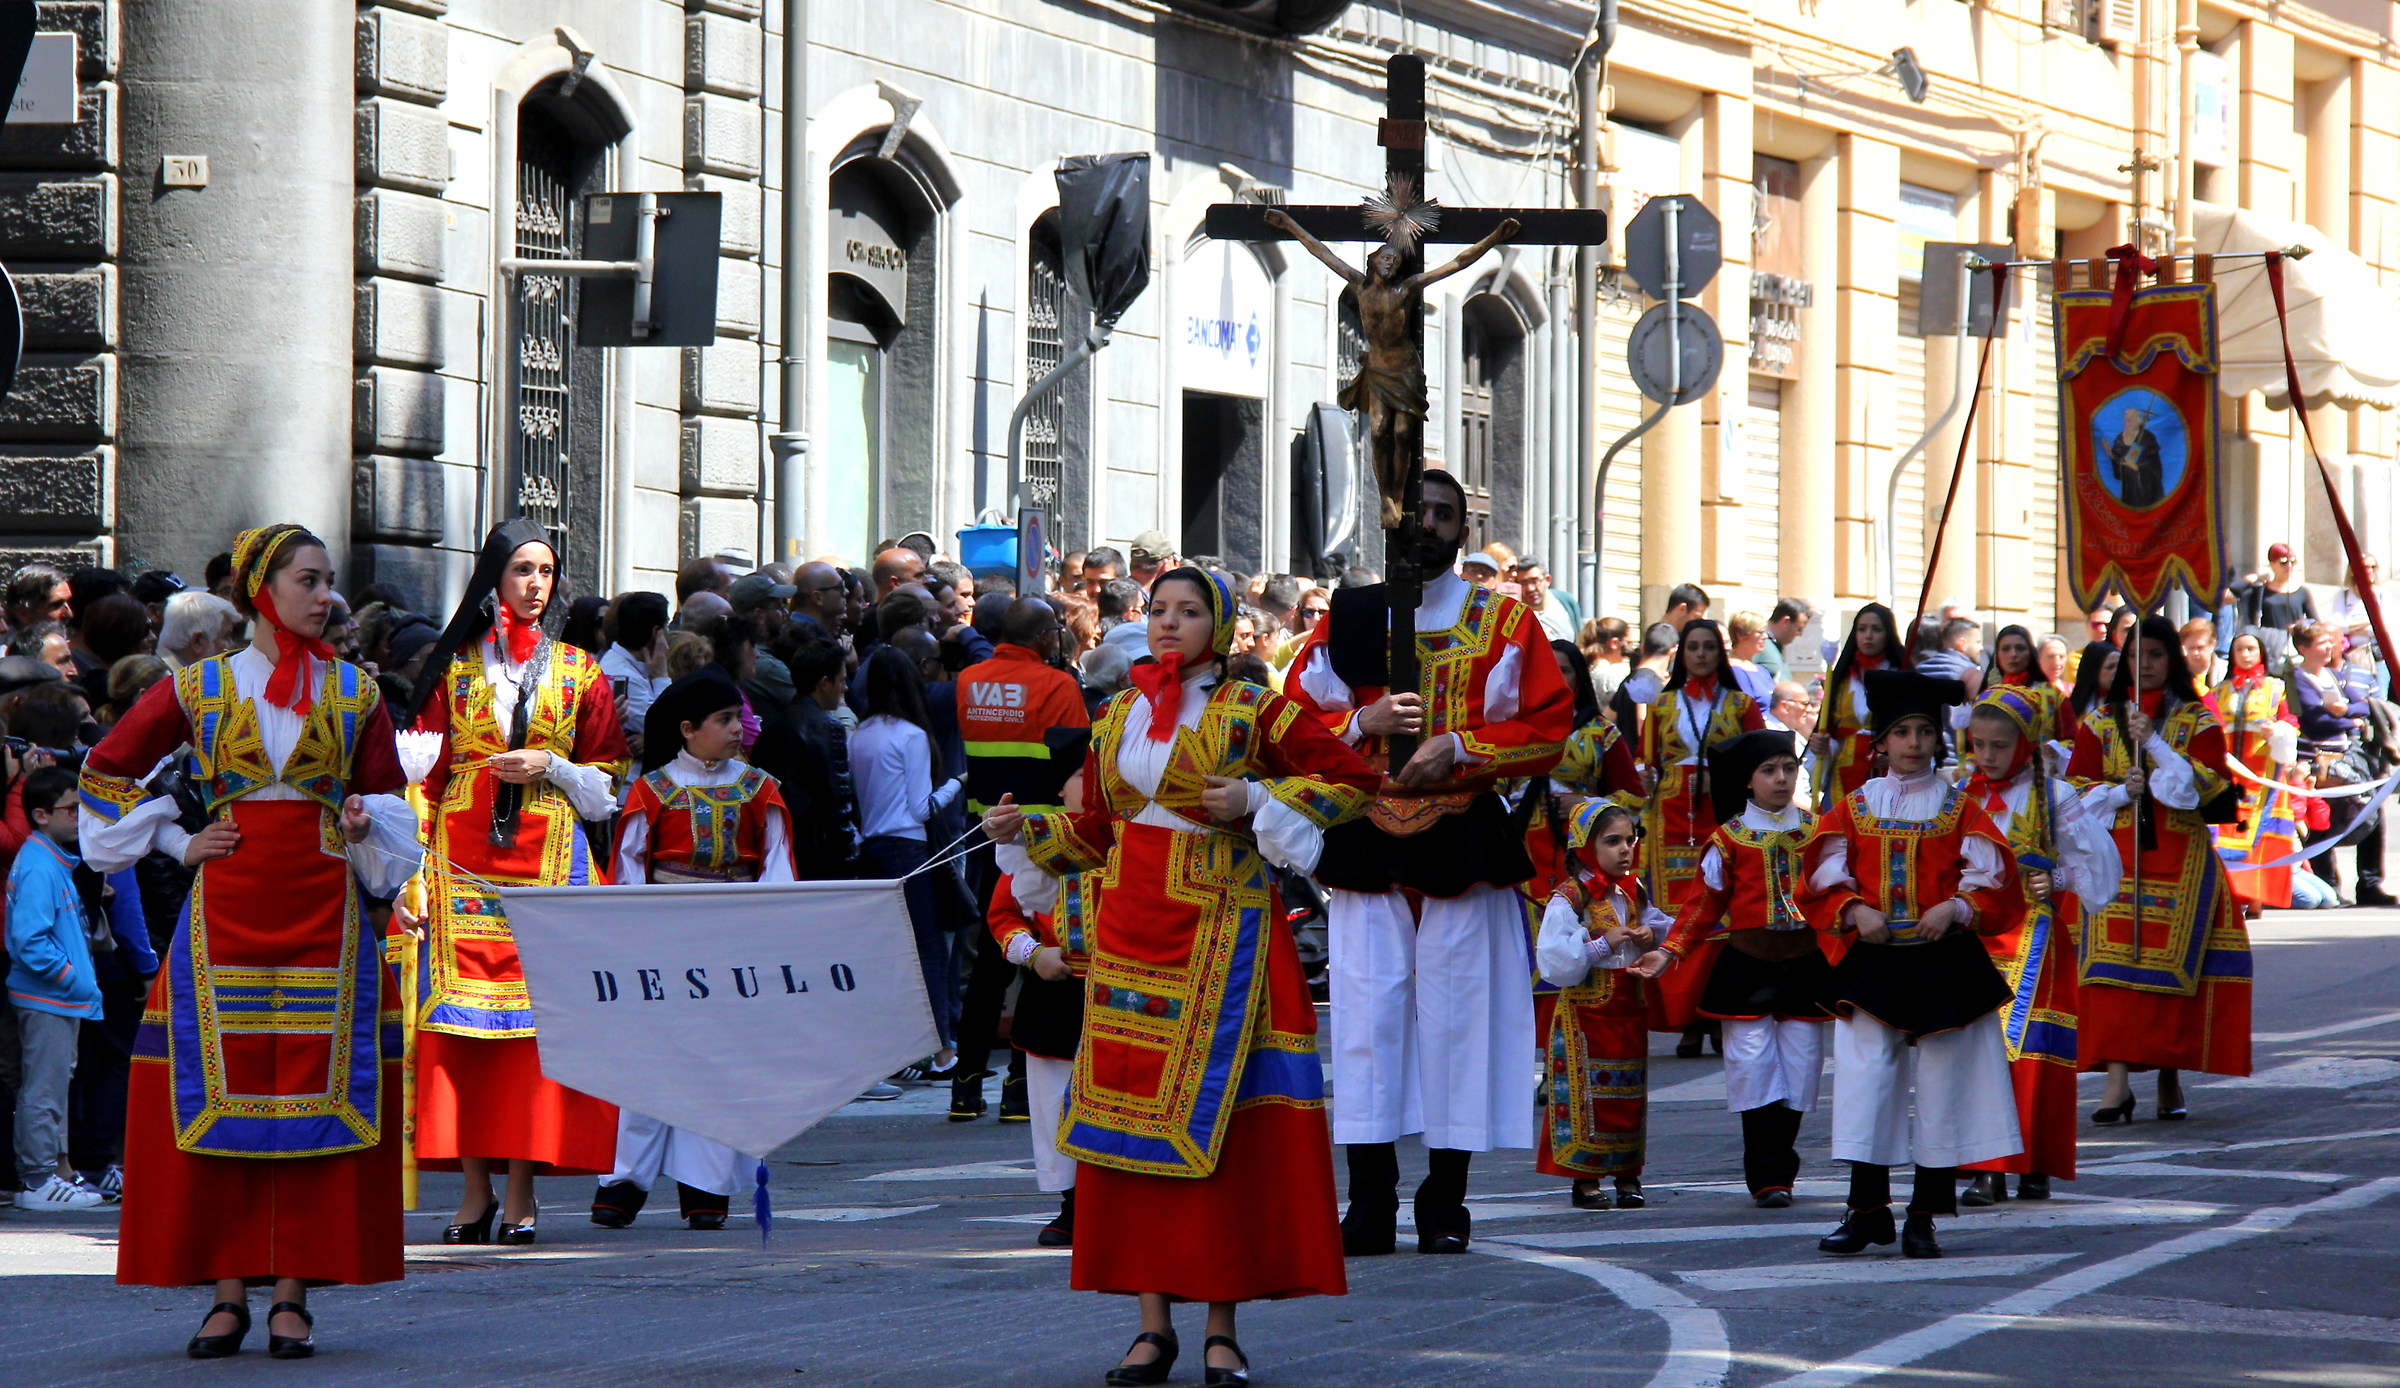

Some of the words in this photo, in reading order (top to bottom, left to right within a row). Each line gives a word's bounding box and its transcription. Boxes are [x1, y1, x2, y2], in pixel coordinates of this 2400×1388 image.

[1187, 316, 1242, 351] BANCOMAT
[967, 707, 1024, 718] ANTINCENDIO
[592, 963, 856, 1002] DESULO
